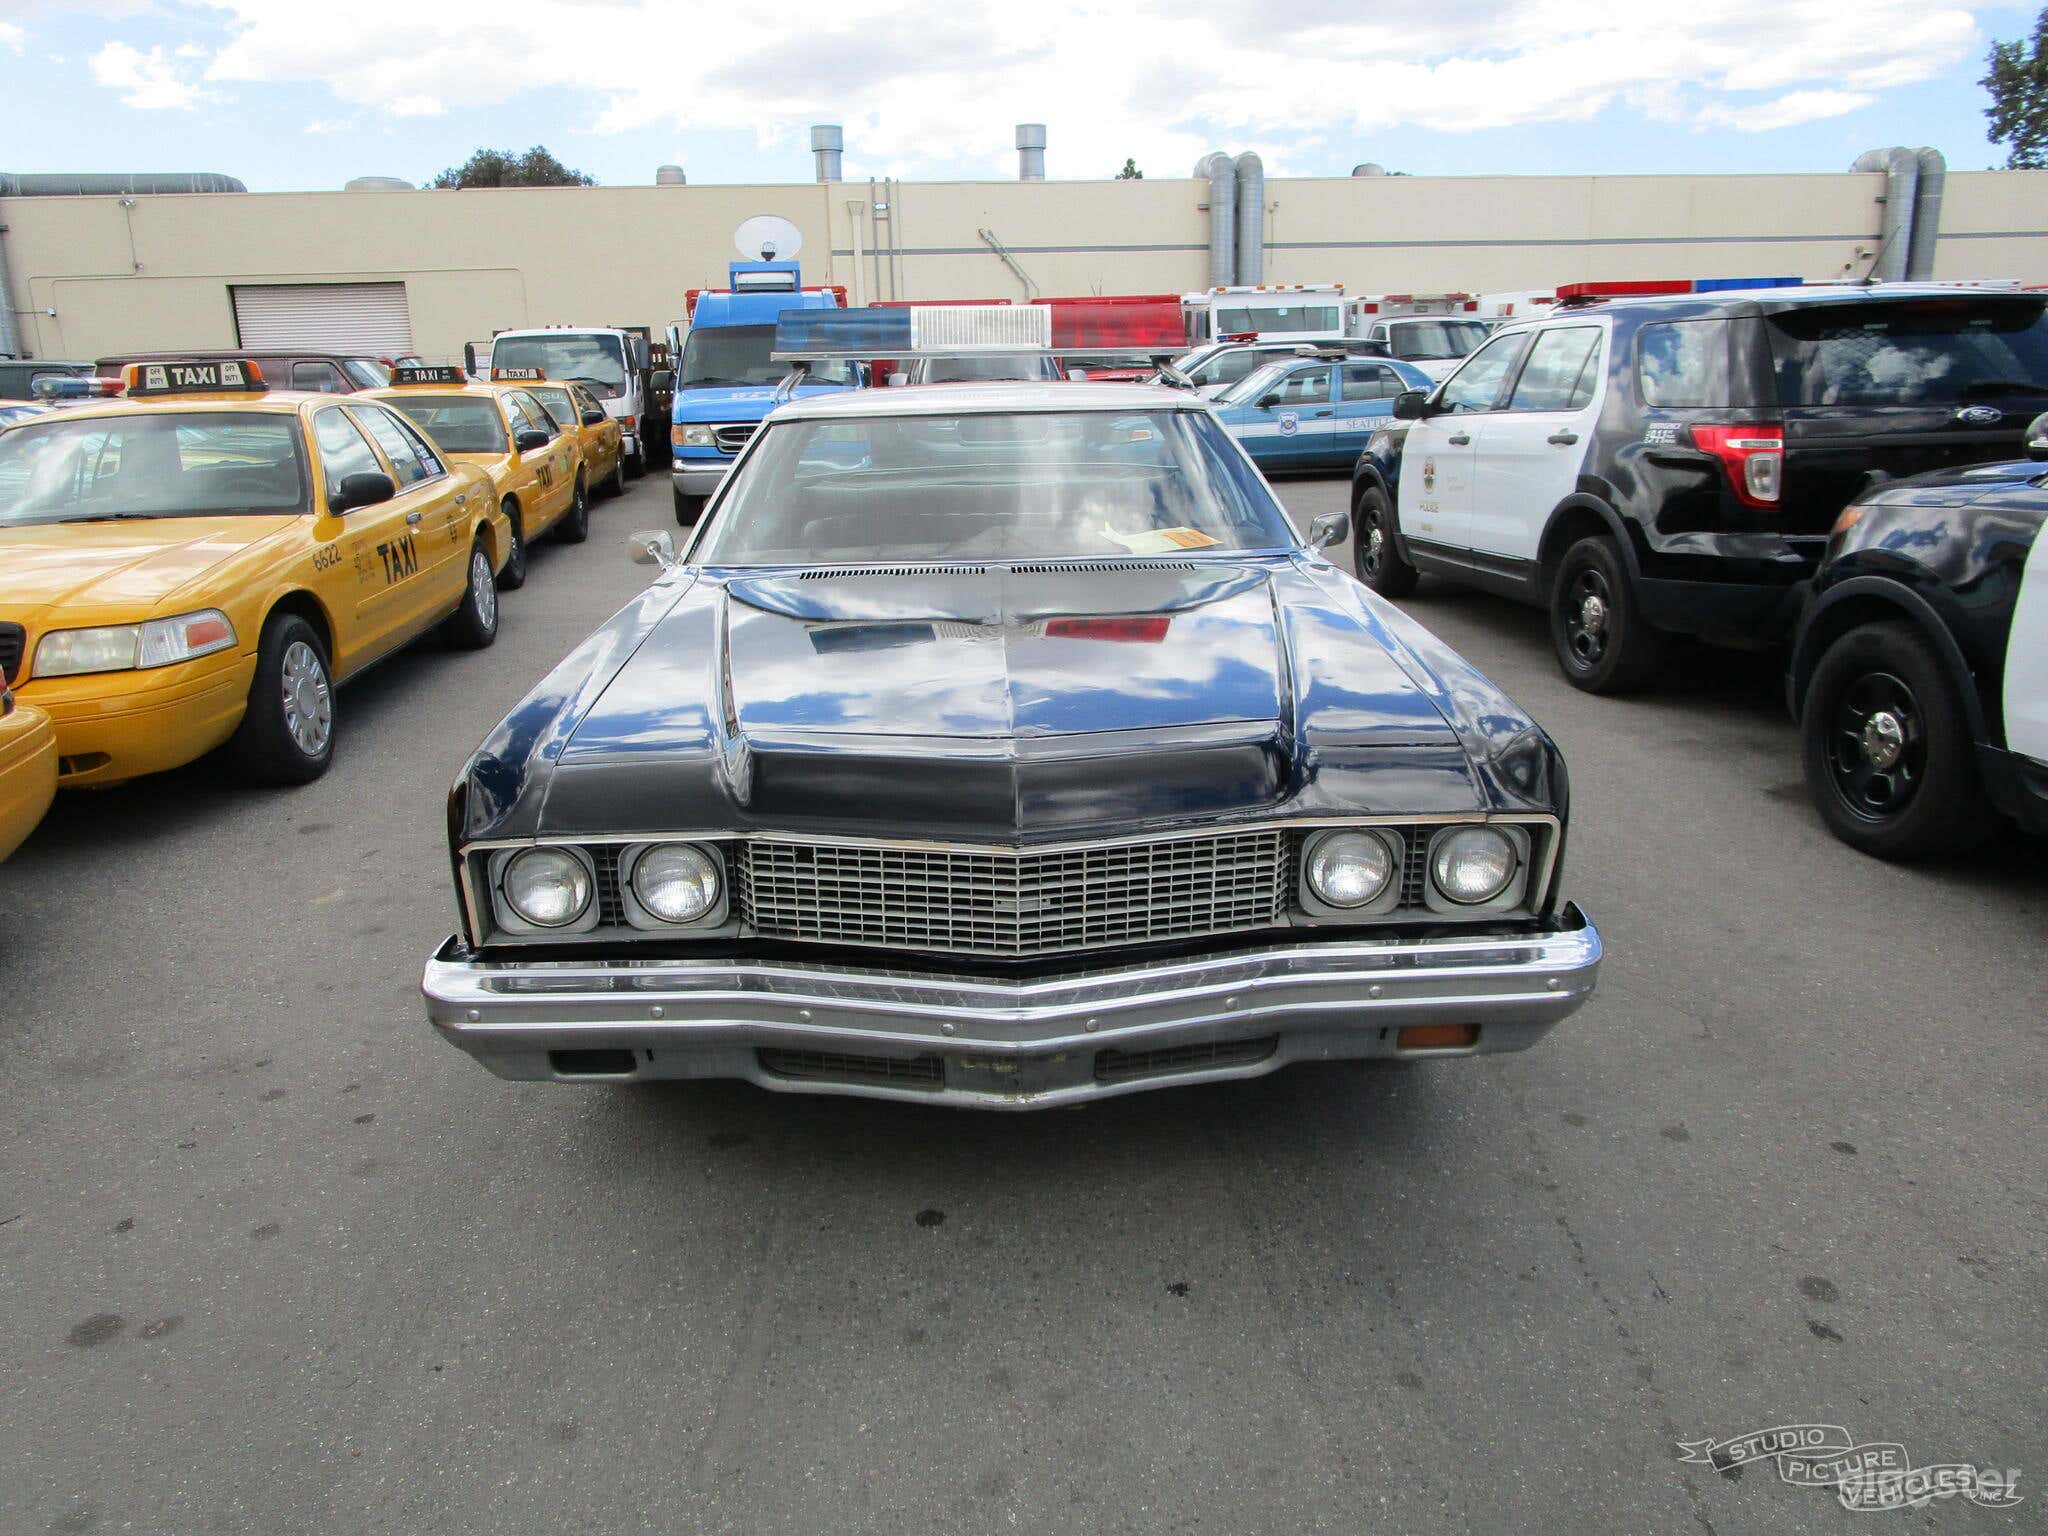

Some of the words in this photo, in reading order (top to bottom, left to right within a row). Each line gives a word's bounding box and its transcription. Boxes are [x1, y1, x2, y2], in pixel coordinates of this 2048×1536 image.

[171, 367, 217, 385] TAXI
[414, 369, 439, 381] TAXI
[509, 370, 527, 378] TAXI
[313, 543, 343, 571] 6622
[376, 533, 418, 585] TAXI
